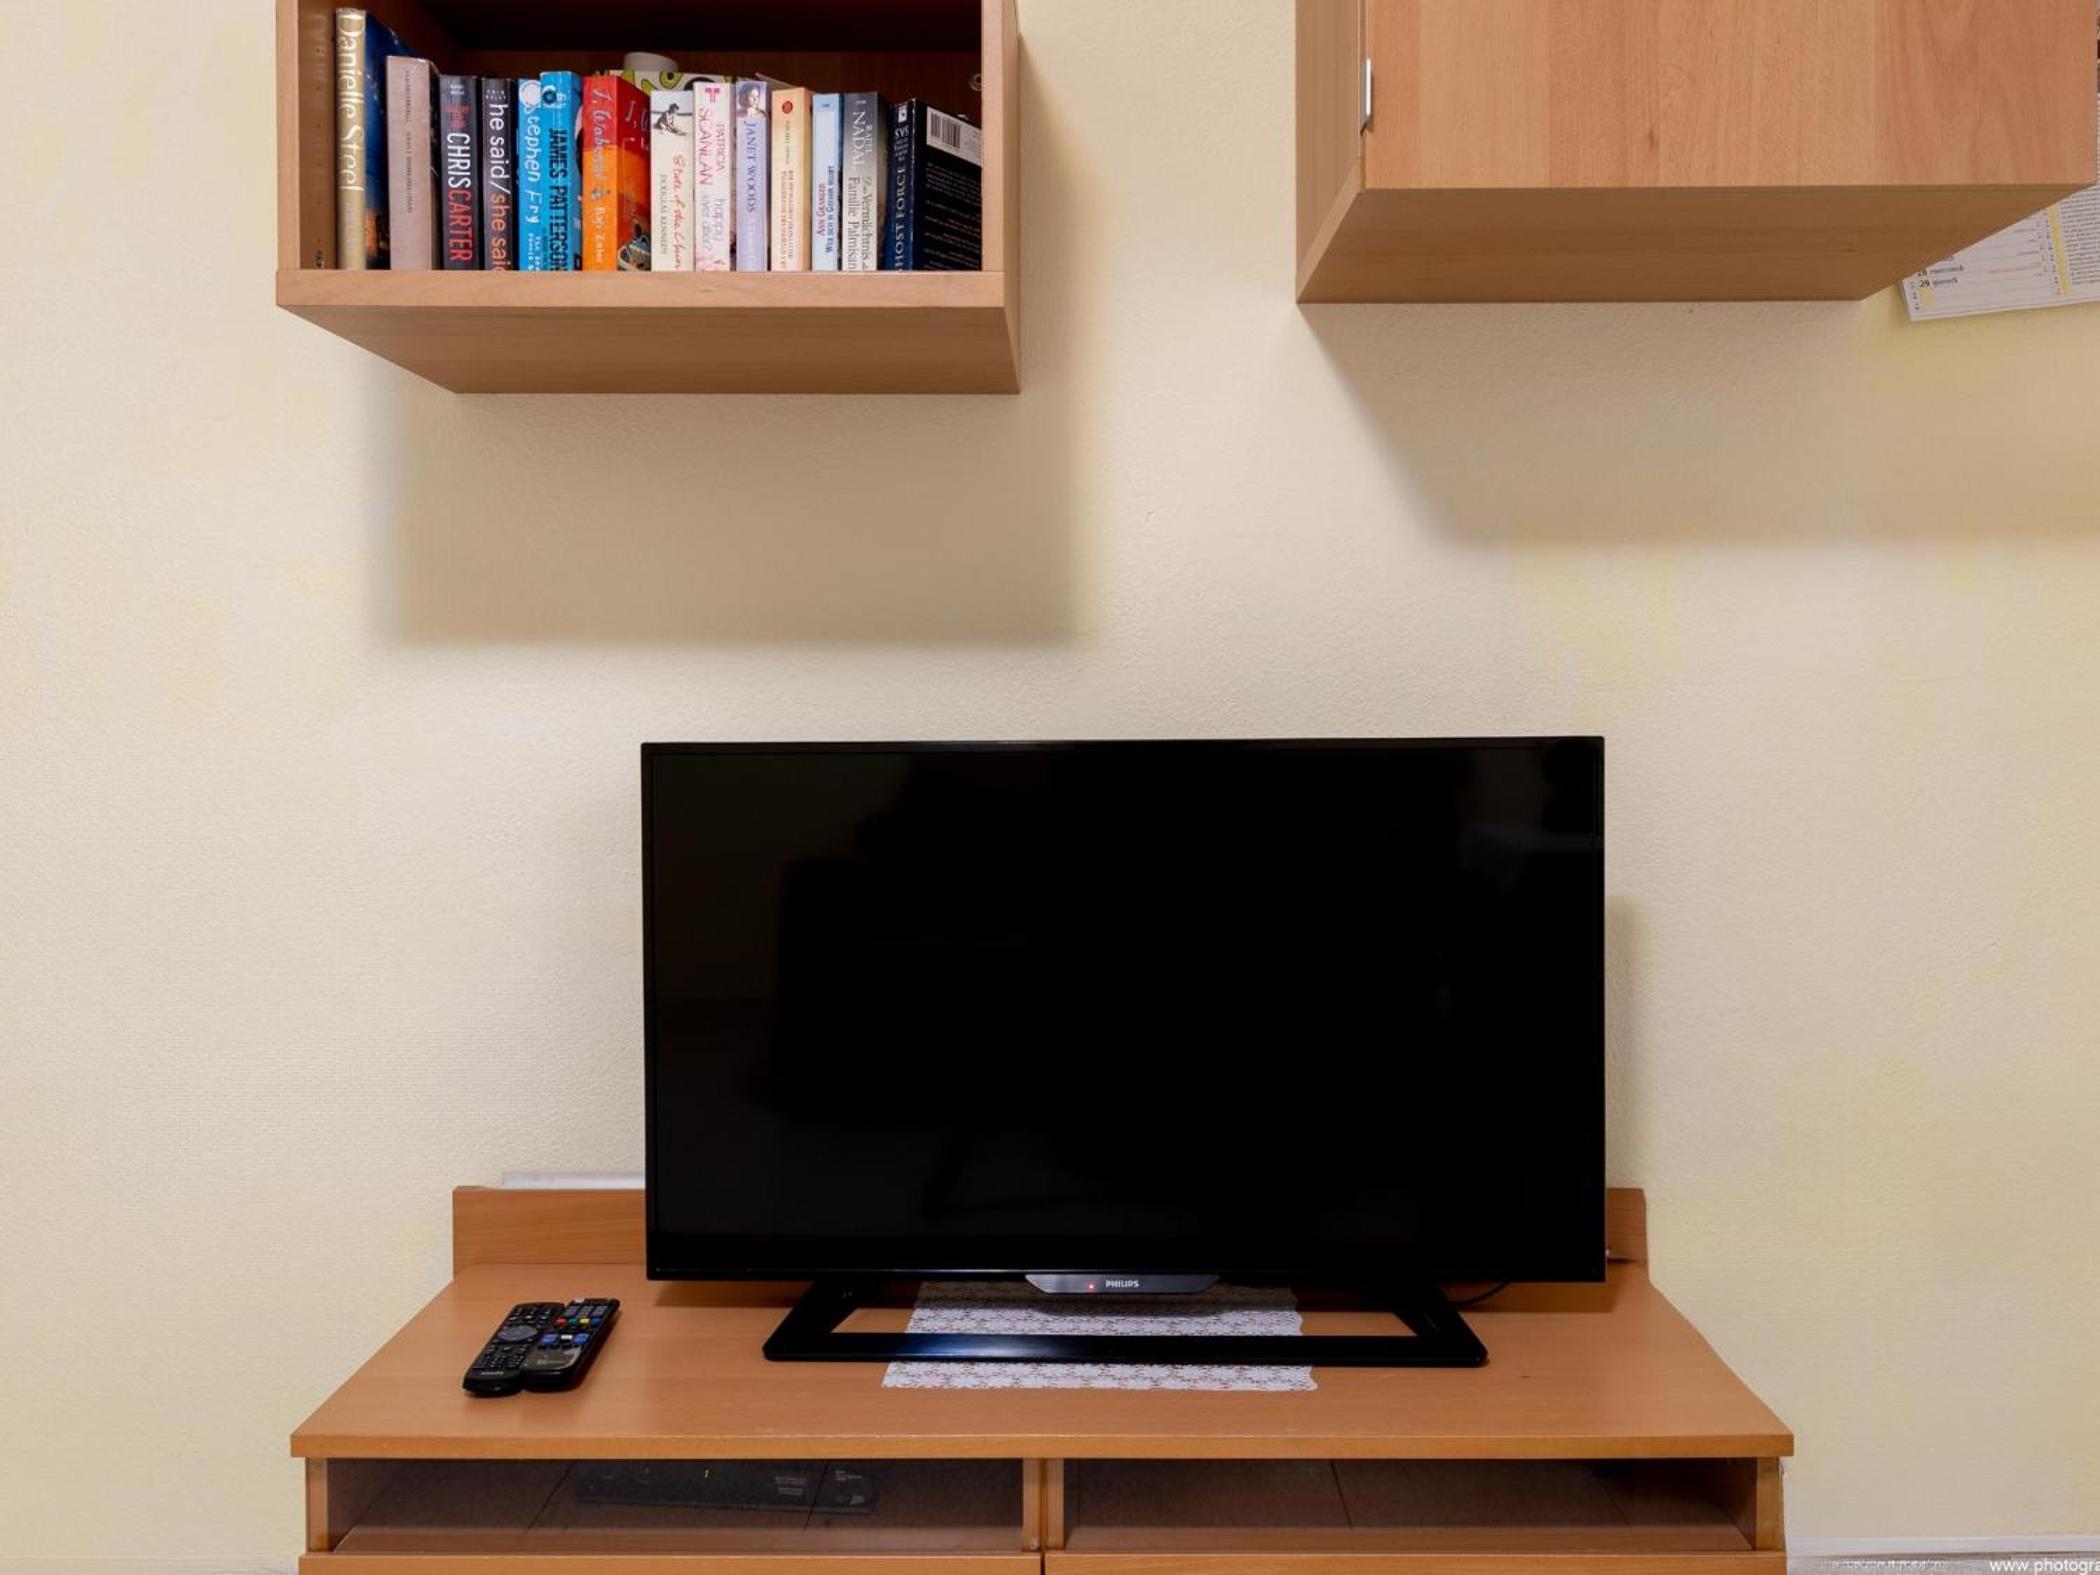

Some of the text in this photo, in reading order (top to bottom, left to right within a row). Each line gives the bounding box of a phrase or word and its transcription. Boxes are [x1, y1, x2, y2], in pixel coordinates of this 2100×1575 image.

[339, 14, 365, 119] Danielle
[489, 104, 508, 131] he
[744, 120, 757, 162] JANET
[852, 111, 865, 167] NADAL
[340, 124, 365, 191] Steel
[447, 133, 471, 189] CHRIS
[715, 124, 726, 171] PATRICIA
[525, 191, 542, 224] Fry
[548, 128, 568, 270] JAMES PATTERSON
[746, 165, 757, 214] WOODS
[448, 189, 472, 262] CARTER
[848, 176, 861, 270] Familie Palmisan
[895, 223, 905, 272] HOST
[1105, 1279, 1139, 1288] PHILIPS
